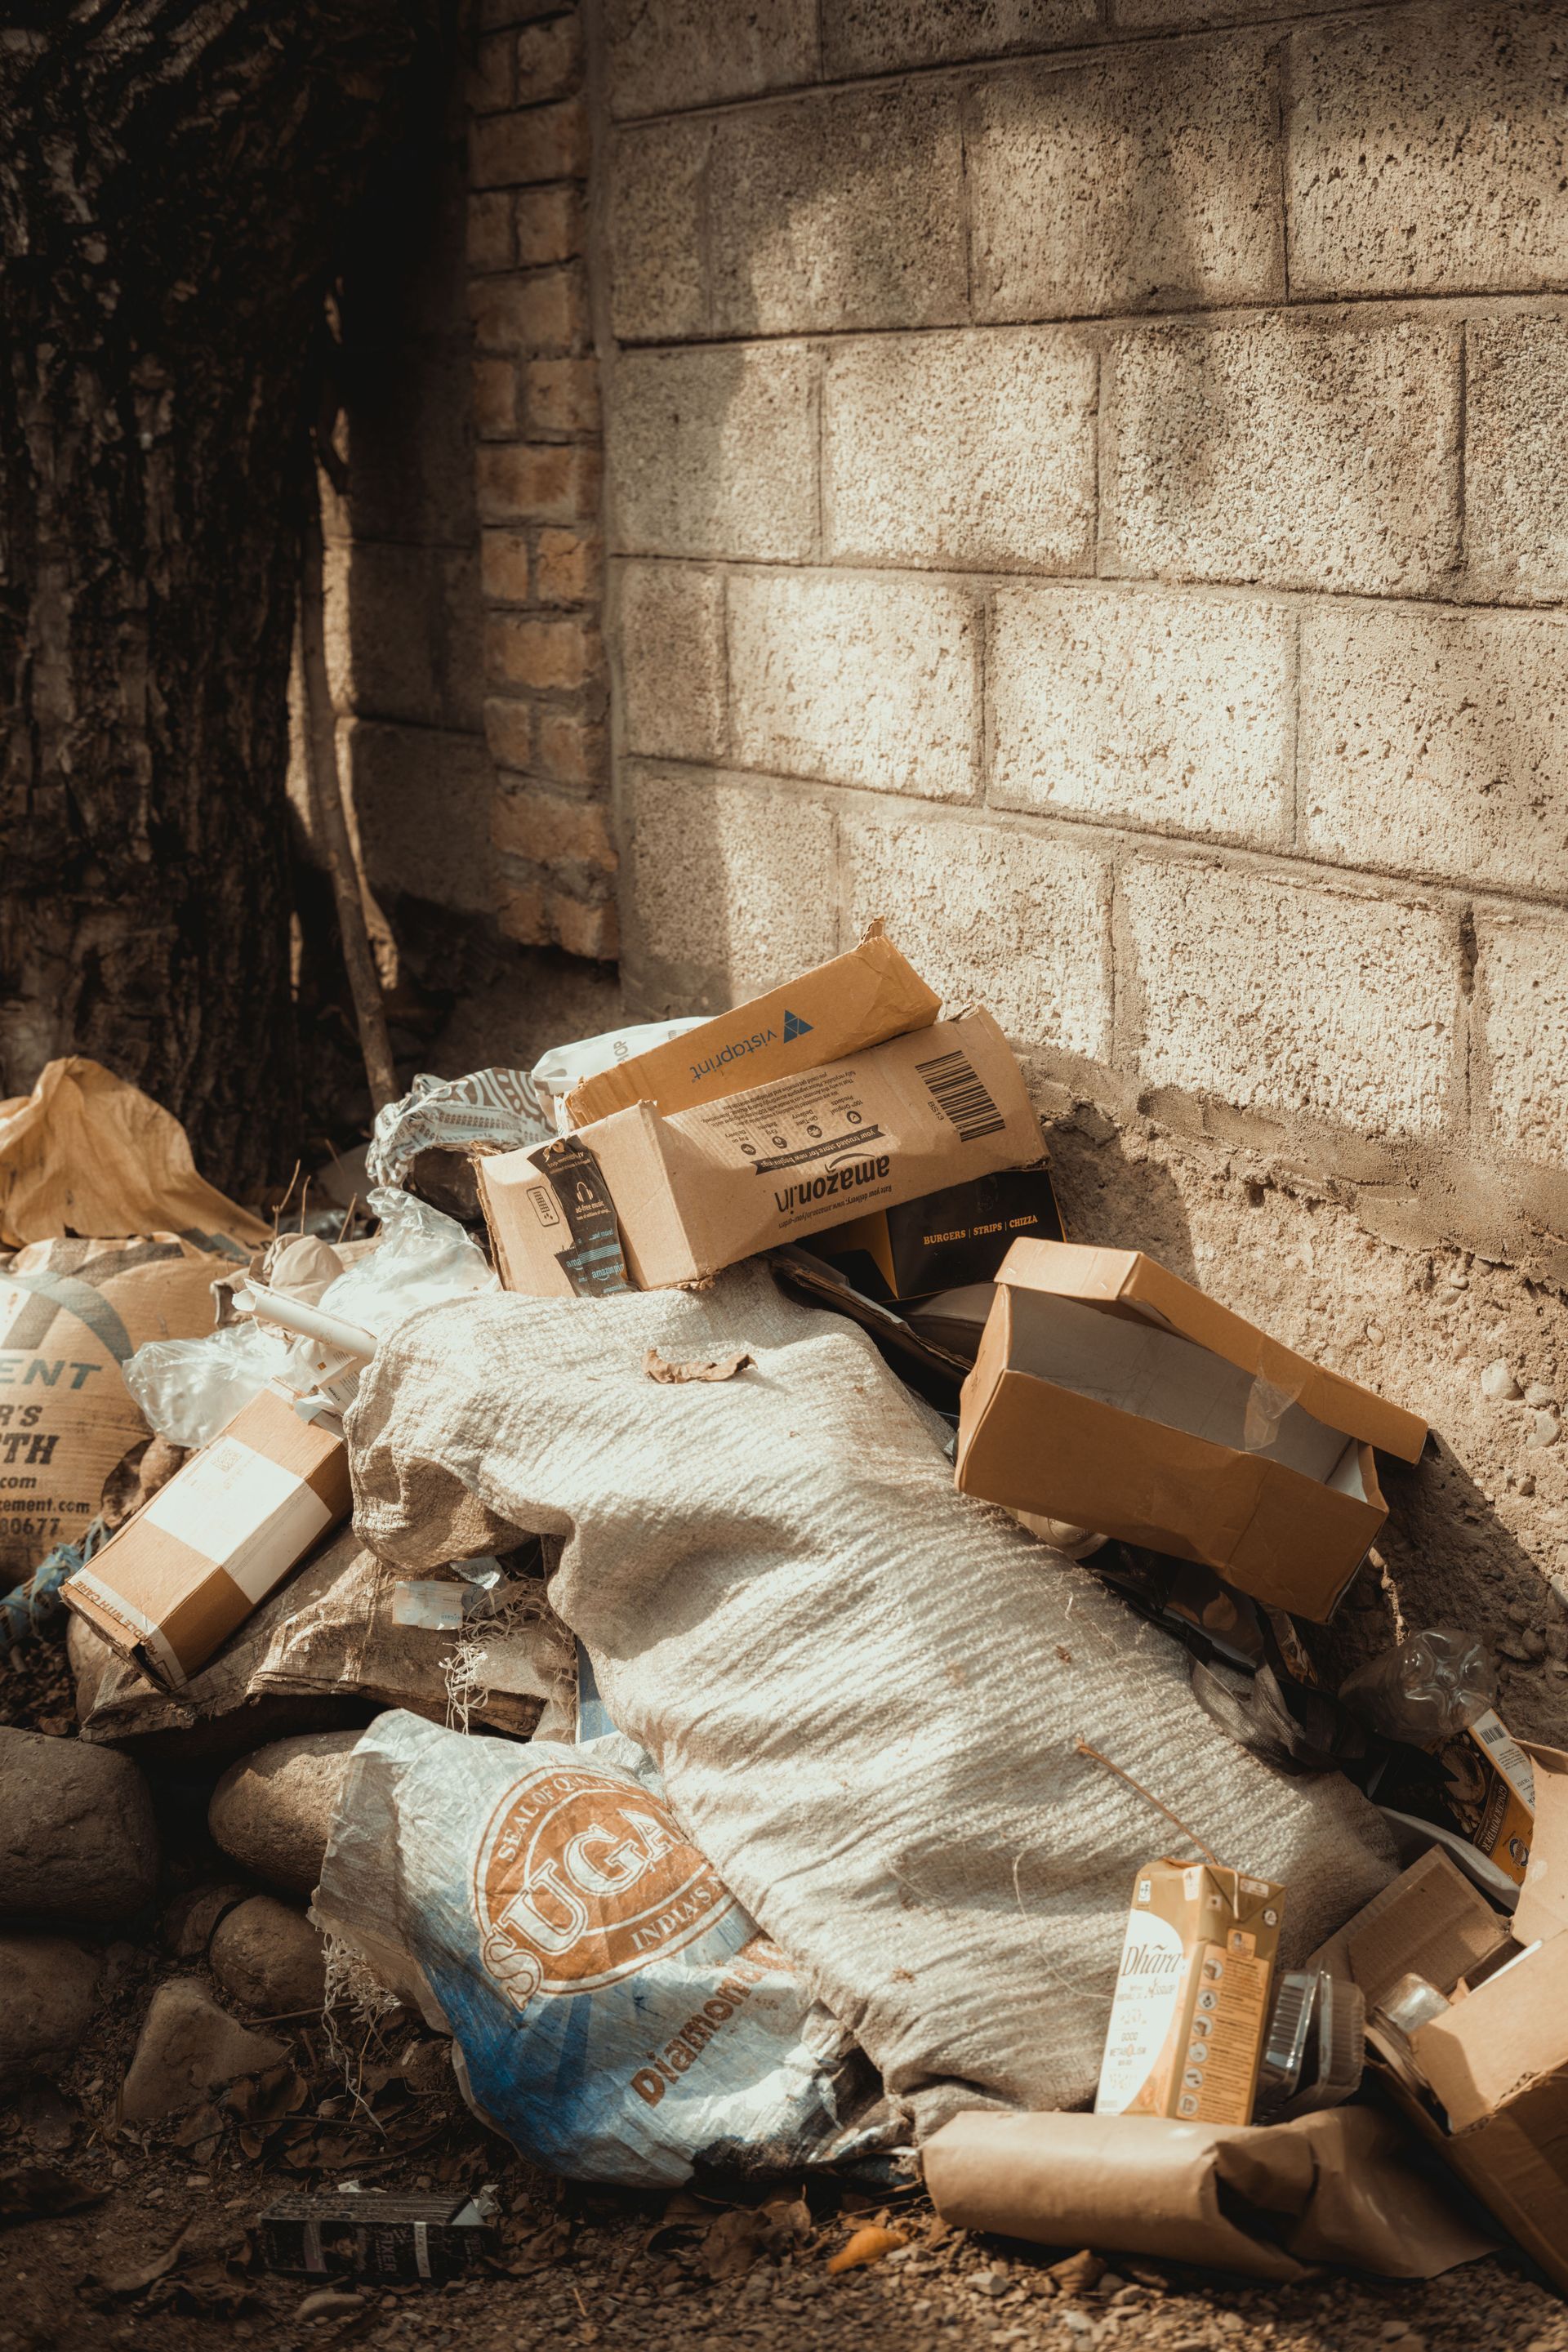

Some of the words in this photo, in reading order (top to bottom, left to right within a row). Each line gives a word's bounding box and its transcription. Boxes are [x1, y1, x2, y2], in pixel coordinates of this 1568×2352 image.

[689, 1028, 777, 1082] vistaprint
[830, 1095, 853, 1105] Products
[791, 1109, 813, 1119] Delivery
[829, 1103, 851, 1114] Original
[927, 1098, 945, 1122] BS13
[795, 1116, 817, 1125] On-Time
[724, 1129, 746, 1138] Delivery
[859, 1129, 875, 1139] your
[835, 1134, 860, 1147] trusted
[807, 1148, 819, 1158] for
[817, 1143, 835, 1153] store
[794, 1152, 808, 1161] new
[775, 1155, 890, 1214] amazon.in
[880, 1184, 892, 1194] Rate
[868, 1188, 880, 1197] your
[574, 1202, 591, 1213] ad-free
[923, 1229, 966, 1245] BURGERS
[972, 1222, 1003, 1235] STRIPS
[1008, 1214, 1038, 1227] CHIZZA
[0, 1358, 102, 1390] ENT
[0, 1404, 42, 1428] R'S
[74, 1580, 101, 1601] CARE
[98, 1600, 124, 1622] WITH
[1494, 1784, 1509, 1816] GINGER
[497, 1805, 540, 1863] SEAL
[532, 1784, 556, 1806] OF
[1482, 1813, 1501, 1853] POWDER
[629, 1882, 712, 1952] INDIA'S
